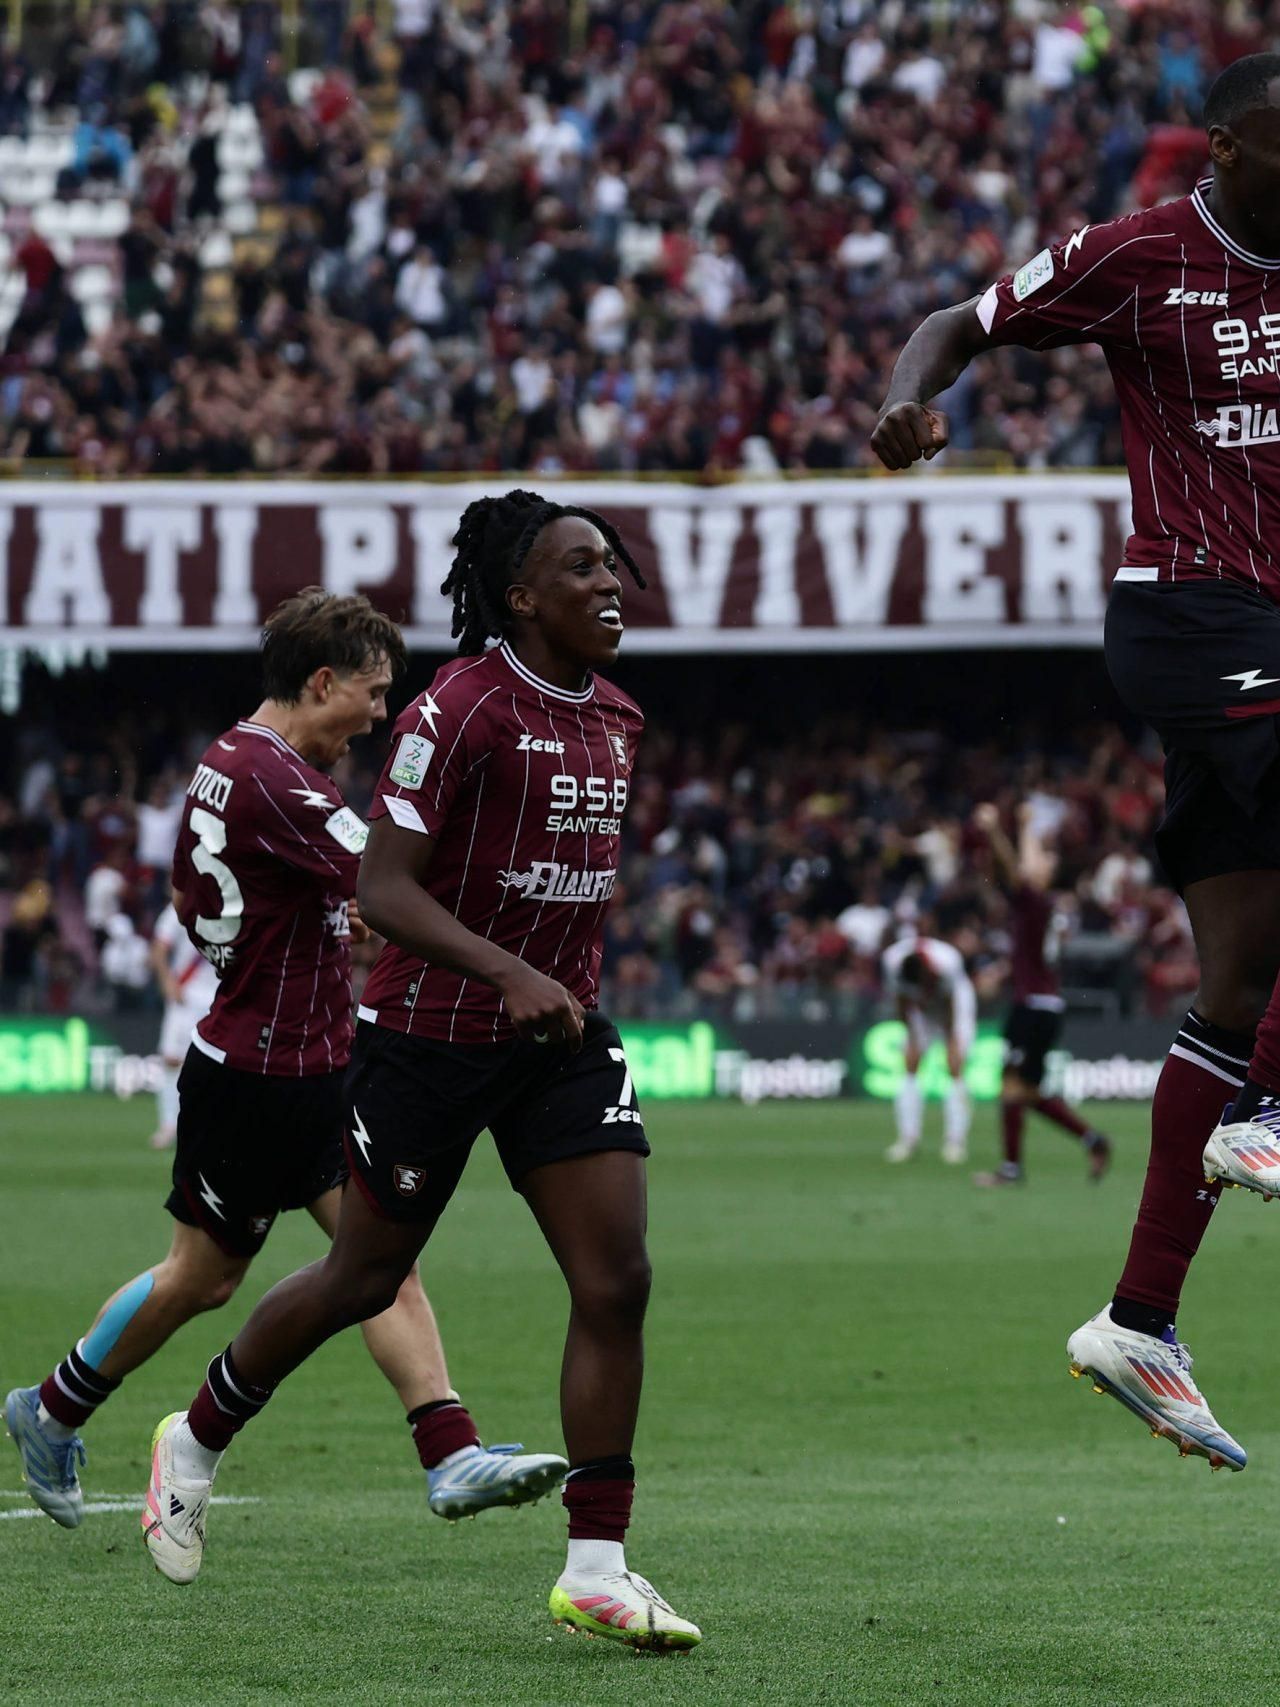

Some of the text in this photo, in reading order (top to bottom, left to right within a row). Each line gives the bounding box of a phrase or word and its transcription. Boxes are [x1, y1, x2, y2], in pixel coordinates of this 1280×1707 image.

[1163, 288, 1229, 306] Zeus
[0, 503, 259, 627] ATI
[317, 504, 458, 625] PE
[648, 503, 1132, 627] VIVER
[516, 734, 565, 754] Zeus
[187, 763, 234, 813] TUCCI
[545, 815, 620, 835] SANTERO
[190, 806, 244, 944] 3
[88, 1045, 166, 1100] Tips
[607, 1047, 633, 1107] 7
[622, 1020, 715, 1099] sal
[715, 1050, 847, 1106] Tipster
[601, 1106, 644, 1127] Zeu
[1195, 1189, 1217, 1206] Ze
